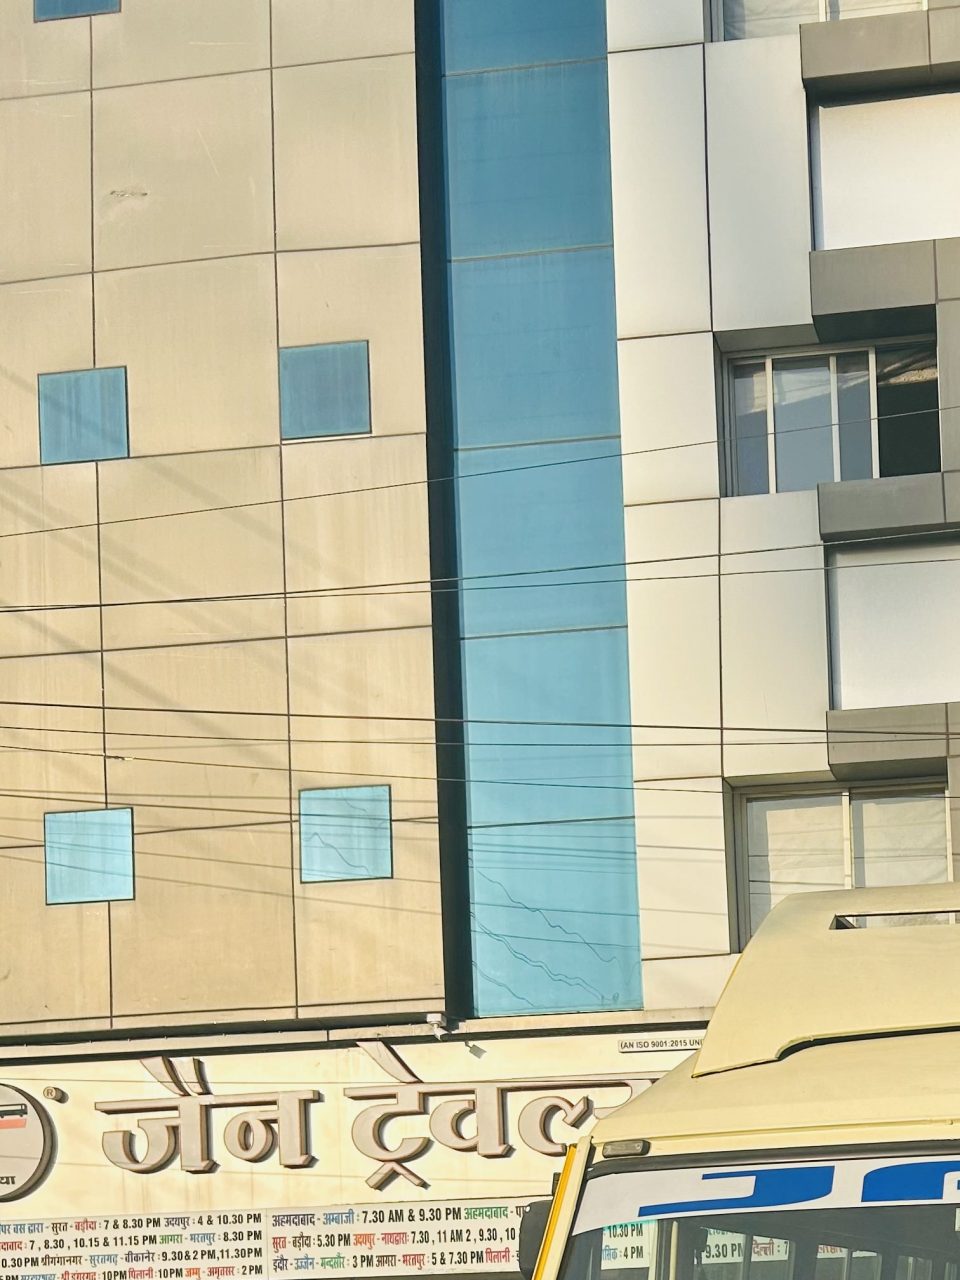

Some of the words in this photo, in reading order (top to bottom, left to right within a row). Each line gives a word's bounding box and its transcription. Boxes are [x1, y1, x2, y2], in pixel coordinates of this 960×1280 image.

[636, 1041, 649, 1049] ISO
[95, 1057, 324, 1175] जैन
[104, 1219, 110, 1230] 7
[113, 1218, 120, 1230] &
[123, 1217, 143, 1230] 8.30
[146, 1217, 160, 1228] PM
[198, 1216, 203, 1226] 4
[207, 1214, 214, 1225] &
[218, 1214, 243, 1225] 10.30
[247, 1213, 261, 1223] PM
[272, 1213, 315, 1227] अहमदाबाद
[362, 1210, 385, 1224] 7.30
[388, 1209, 404, 1222] AM
[408, 1208, 415, 1222] &
[420, 1207, 442, 1221] 9.30
[445, 1206, 461, 1220] PM
[464, 1205, 509, 1220] अहमदाबाद
[317, 1233, 335, 1247] 5.30
[338, 1233, 351, 1246] PM
[411, 1230, 429, 1244] 7.30
[437, 1230, 447, 1243] 11
[450, 1229, 463, 1242] AM
[466, 1228, 471, 1241] 2
[479, 1227, 497, 1241] 9.30
[631, 1223, 643, 1236] PM
[30, 1239, 35, 1250] 7
[44, 1238, 64, 1249] 8.30
[74, 1237, 99, 1248] 10.15
[103, 1236, 110, 1247] &
[113, 1235, 139, 1246] 11.15
[142, 1234, 157, 1245] PM
[223, 1230, 244, 1242] 8.30
[247, 1230, 262, 1241] PM
[624, 1247, 628, 1259] 4
[631, 1246, 643, 1259] PM
[705, 1242, 728, 1258] 9.30
[352, 1255, 358, 1268] 3
[360, 1254, 374, 1268] PM
[431, 1252, 437, 1265] 5
[440, 1251, 446, 1265] &
[449, 1251, 468, 1264] 7.30
[470, 1250, 484, 1263] PM
